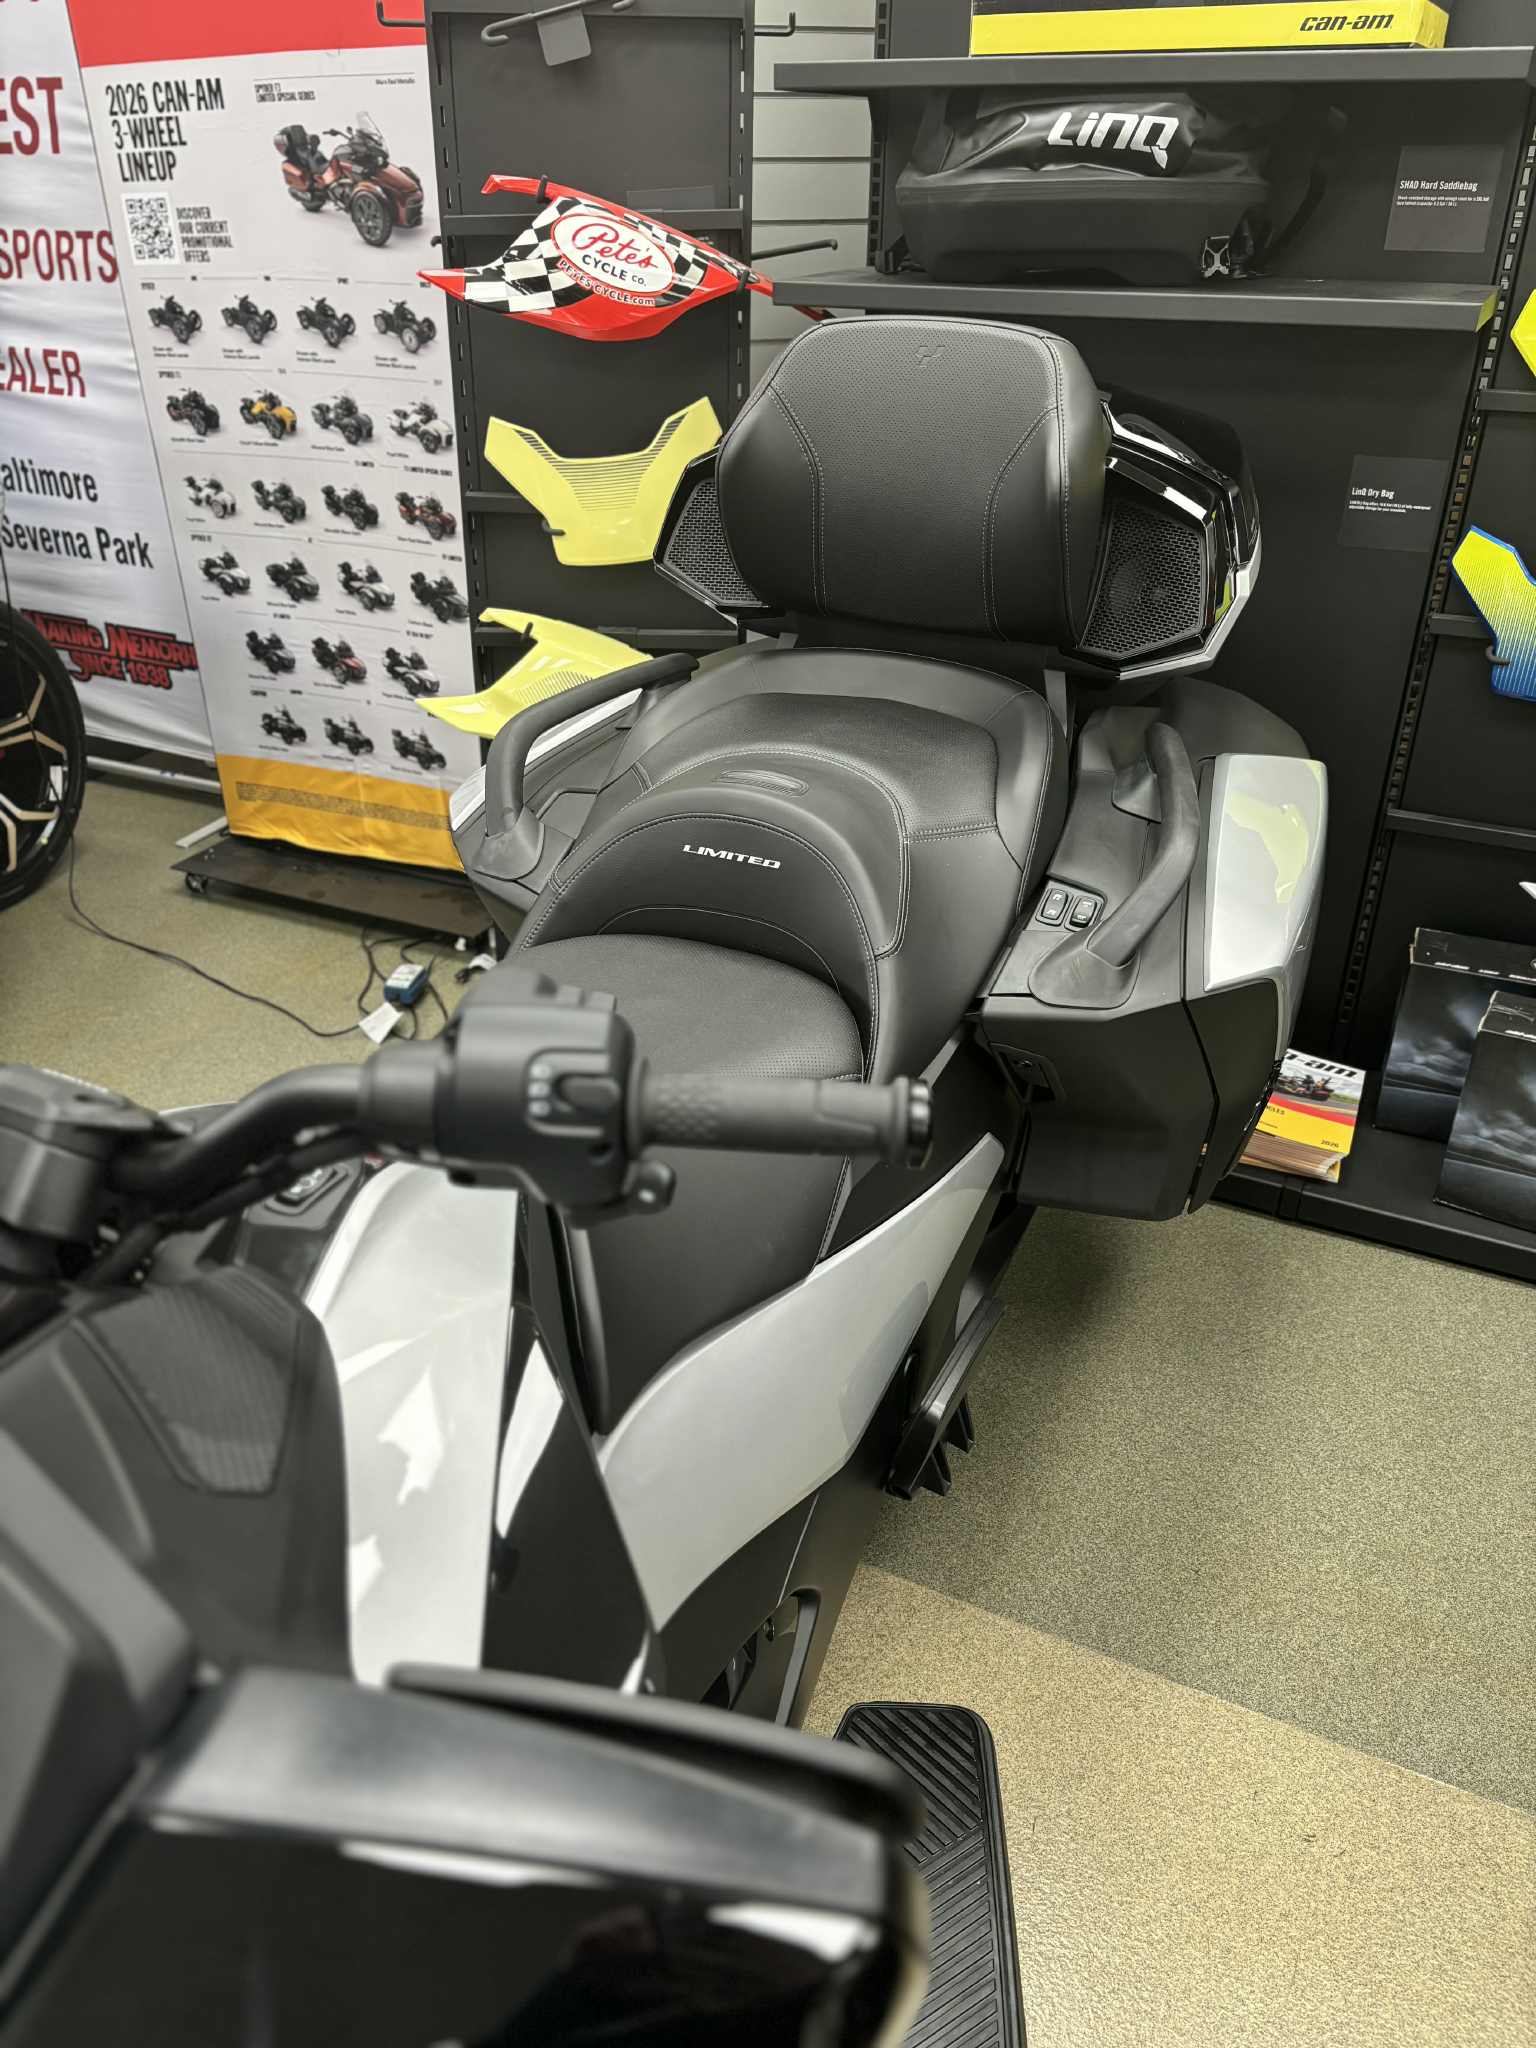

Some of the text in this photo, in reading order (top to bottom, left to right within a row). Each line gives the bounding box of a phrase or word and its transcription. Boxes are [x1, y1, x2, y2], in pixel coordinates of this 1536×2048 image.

[1300, 13, 1394, 33] can-am
[105, 78, 225, 116] 2026 CAN-AM
[112, 116, 187, 149] 3-WHEEL
[117, 150, 176, 183] LINEUP
[1400, 180, 1478, 192] SHAD Hard Saddlebag
[176, 206, 211, 220] DISCOVER
[195, 220, 228, 234] CURRENT
[181, 235, 234, 249] PROMOTIONAL
[184, 250, 211, 263] OFFERS
[572, 223, 658, 269] Pete's
[582, 254, 647, 287] CYCLE CO.
[0, 346, 86, 398] ALER
[1, 457, 98, 502] altimore
[1367, 488, 1380, 499] Dry
[1380, 489, 1395, 499] Bag
[1, 514, 154, 569] Severna Park
[128, 660, 171, 689] 1938
[683, 844, 781, 868] LIMITED
